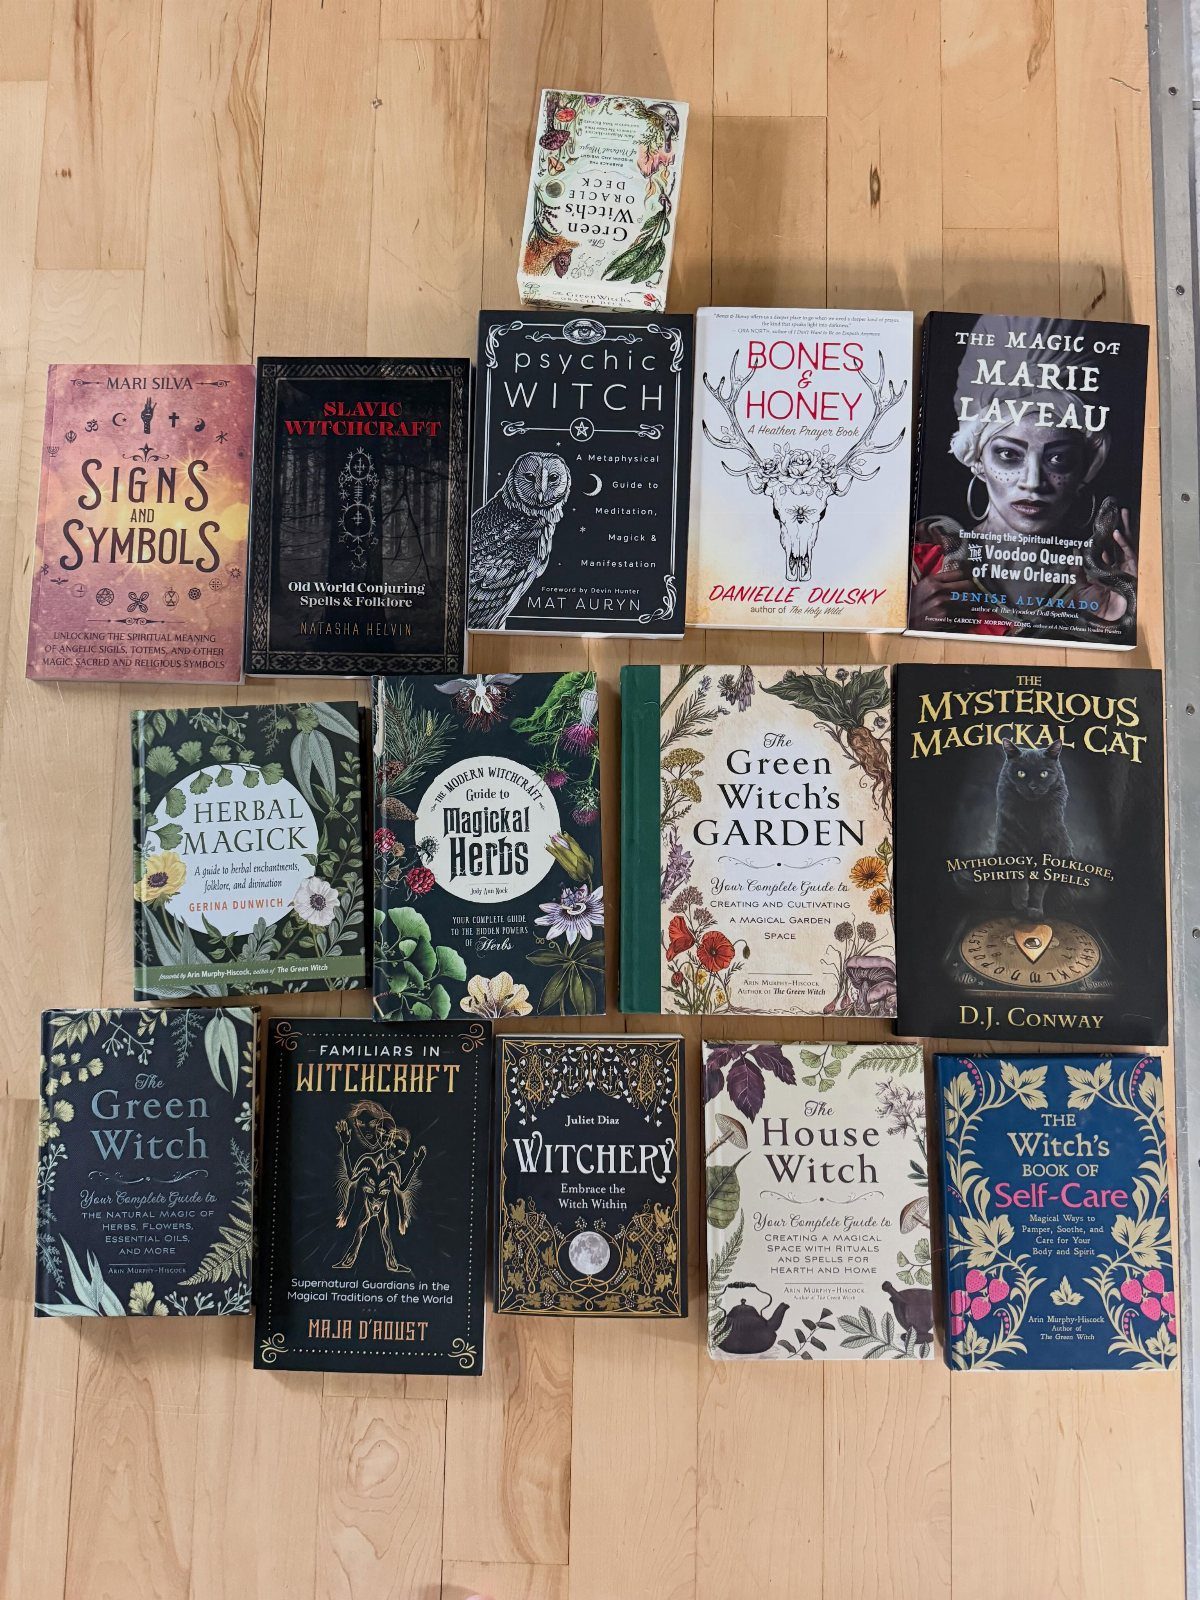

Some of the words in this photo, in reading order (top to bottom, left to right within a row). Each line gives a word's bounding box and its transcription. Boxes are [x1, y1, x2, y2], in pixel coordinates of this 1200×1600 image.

[582, 178, 625, 190] DECK
[569, 190, 634, 204] ORACLE
[566, 203, 634, 224] Witch's
[568, 222, 627, 241] Green
[589, 239, 605, 248] The
[955, 332, 995, 346] THE
[1005, 332, 1085, 352] MAGIC
[1094, 341, 1120, 355] OF
[515, 350, 655, 374] psychic
[748, 341, 864, 371] BONES
[107, 378, 146, 390] MARI
[152, 378, 193, 390] SILVA
[798, 370, 813, 388] &
[971, 359, 1100, 392] MARIE
[504, 382, 661, 411] WITCH
[746, 390, 862, 421] HONEY
[323, 402, 402, 417] SLAVIC
[958, 397, 1110, 432] LAVEAU
[285, 420, 441, 437] WITCHCRAFT
[748, 425, 755, 434] A
[758, 425, 796, 435] Heathen
[799, 426, 833, 440] Prayer
[836, 427, 859, 436] Book
[588, 455, 659, 463] Metaphysical
[78, 459, 208, 511] SIGNS
[612, 481, 643, 489] Guide
[130, 509, 154, 522] AND
[596, 508, 657, 516] Meditation,
[60, 519, 220, 572] SYMBOLS
[608, 534, 645, 542] Magick
[959, 530, 1001, 543] Embracing
[1004, 533, 1016, 541] the
[1018, 534, 1053, 545] Spiritual
[1055, 536, 1082, 549] Legacy
[1083, 539, 1093, 547] of
[581, 560, 656, 568] Manifestation
[985, 545, 1036, 563] Voodoo
[1040, 549, 1083, 565] Queen
[972, 564, 988, 577] of
[991, 566, 1019, 579] New
[1024, 567, 1076, 584] Orleans
[288, 582, 310, 592] Old
[314, 583, 354, 593] World
[357, 583, 425, 595] Conjuring
[709, 585, 800, 603] DANIELLE
[808, 588, 887, 605] DULSKY
[300, 596, 340, 608] Spells
[343, 597, 352, 606] &
[356, 597, 412, 607] Folklore
[528, 597, 566, 609] MAT
[576, 598, 640, 611] AURYN
[951, 592, 1007, 604] DENISE
[1016, 596, 1099, 611] ALVARADO
[751, 606, 776, 614] author
[789, 606, 802, 614] The
[804, 607, 821, 618] Holy
[54, 632, 105, 640] UNLOCKING
[127, 633, 172, 641] SPIRITUAL
[175, 635, 216, 643] MEANING
[300, 622, 359, 635] NATASHA
[367, 623, 411, 636] HELVIN
[1016, 675, 1042, 686] THE
[918, 689, 1140, 727] MYSTERIOUS
[764, 733, 793, 748] The
[910, 722, 1075, 759] MAGICKAL
[1084, 725, 1147, 764] CAT
[726, 750, 832, 775] Green
[435, 791, 446, 803] THE
[444, 767, 484, 792] MODERN
[489, 767, 543, 802] WITCHCRAFT
[466, 789, 496, 801] Guide
[500, 790, 509, 799] to
[717, 783, 840, 809] Witch's
[194, 798, 304, 823] HERBAL
[443, 806, 530, 838] Magickal
[182, 826, 308, 855] MAGICK
[693, 819, 865, 846] GARDEN
[450, 836, 529, 882] Herbs
[946, 856, 1037, 872] MYTHOLOGY,
[1042, 853, 1114, 881] FOLKLORE,
[195, 866, 200, 875] A
[202, 864, 220, 878] guide
[222, 865, 228, 874] to
[231, 863, 251, 873] herbal
[254, 862, 299, 873] enchantments,
[973, 870, 1025, 883] SPIRITS
[1030, 871, 1039, 880] &
[1043, 869, 1090, 887] SPELLS
[204, 878, 230, 893] folklore,
[233, 878, 246, 889] and
[249, 877, 282, 888] divination
[189, 903, 228, 912] GERINA
[233, 899, 283, 909] DUNWICH
[960, 1005, 999, 1031] D.J.
[1008, 1007, 1104, 1029] CONWAY
[320, 1045, 413, 1057] FAMILIARS
[423, 1046, 440, 1056] IN
[135, 1074, 164, 1089] The
[296, 1063, 460, 1093] WITCHCRAFT
[91, 1090, 210, 1119] Green
[804, 1101, 834, 1117] The
[565, 1115, 595, 1126] Juliet
[598, 1116, 620, 1124] Diaz
[1041, 1114, 1076, 1127] THE
[762, 1118, 880, 1147] House
[90, 1127, 210, 1160] Witch
[1007, 1133, 1110, 1157] Witch's
[512, 1131, 675, 1184] WITCHERY
[764, 1154, 879, 1184] Witch
[1022, 1164, 1069, 1177] BOOK
[1077, 1164, 1099, 1177] OF
[561, 1183, 606, 1194] Embrace
[609, 1184, 626, 1194] the
[994, 1183, 1128, 1208] Self-Care
[558, 1199, 588, 1209] Witch
[591, 1199, 627, 1209] Within
[1029, 1214, 1059, 1223] Magical
[1063, 1214, 1083, 1223] Ways
[765, 1234, 817, 1242] CREATING
[833, 1234, 882, 1242] MAGICAL
[291, 1279, 358, 1289] Supernatural
[362, 1280, 415, 1290] Guardians
[418, 1282, 428, 1290] in
[432, 1282, 450, 1291] the
[287, 1292, 328, 1303] Magical
[331, 1293, 383, 1302] Traditions
[387, 1294, 398, 1302] of
[401, 1294, 419, 1303] the
[422, 1295, 453, 1304] World
[1048, 1316, 1105, 1325] Murphy-Hiscock
[308, 1319, 352, 1339] MAJA
[359, 1319, 428, 1341] D'AOUST
